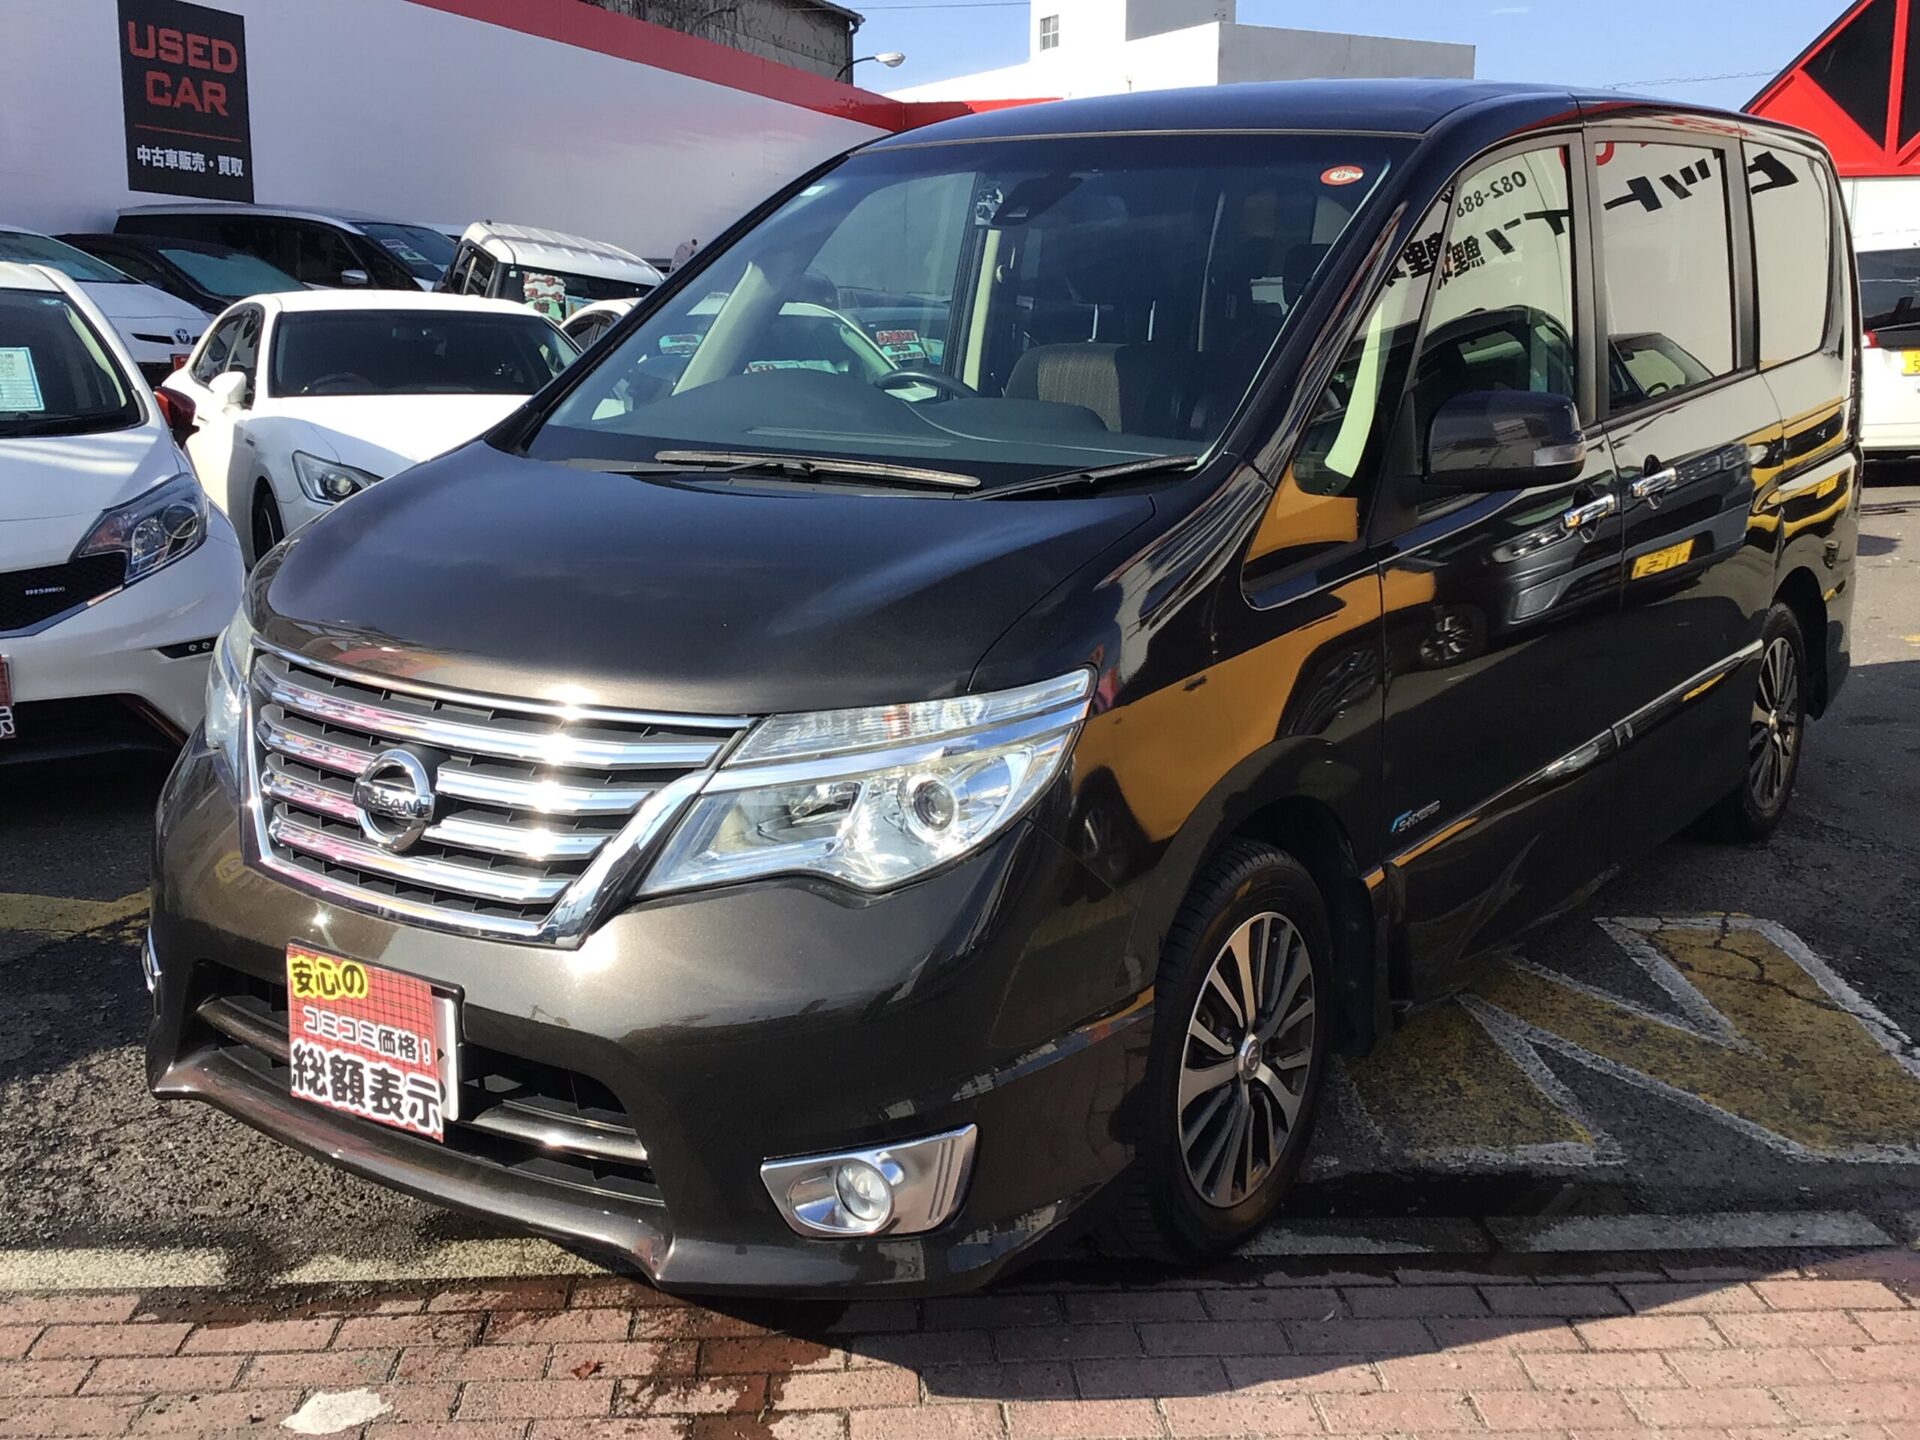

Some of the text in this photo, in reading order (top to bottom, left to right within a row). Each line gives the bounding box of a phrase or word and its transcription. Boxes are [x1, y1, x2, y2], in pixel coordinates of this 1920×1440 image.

[127, 20, 239, 74] USED
[145, 70, 229, 117] CAR
[136, 145, 244, 177] 中古車販売・買取
[291, 960, 365, 996] 安心の
[302, 1006, 432, 1065] コミコミ価格！
[291, 1043, 442, 1130] 総額表示
